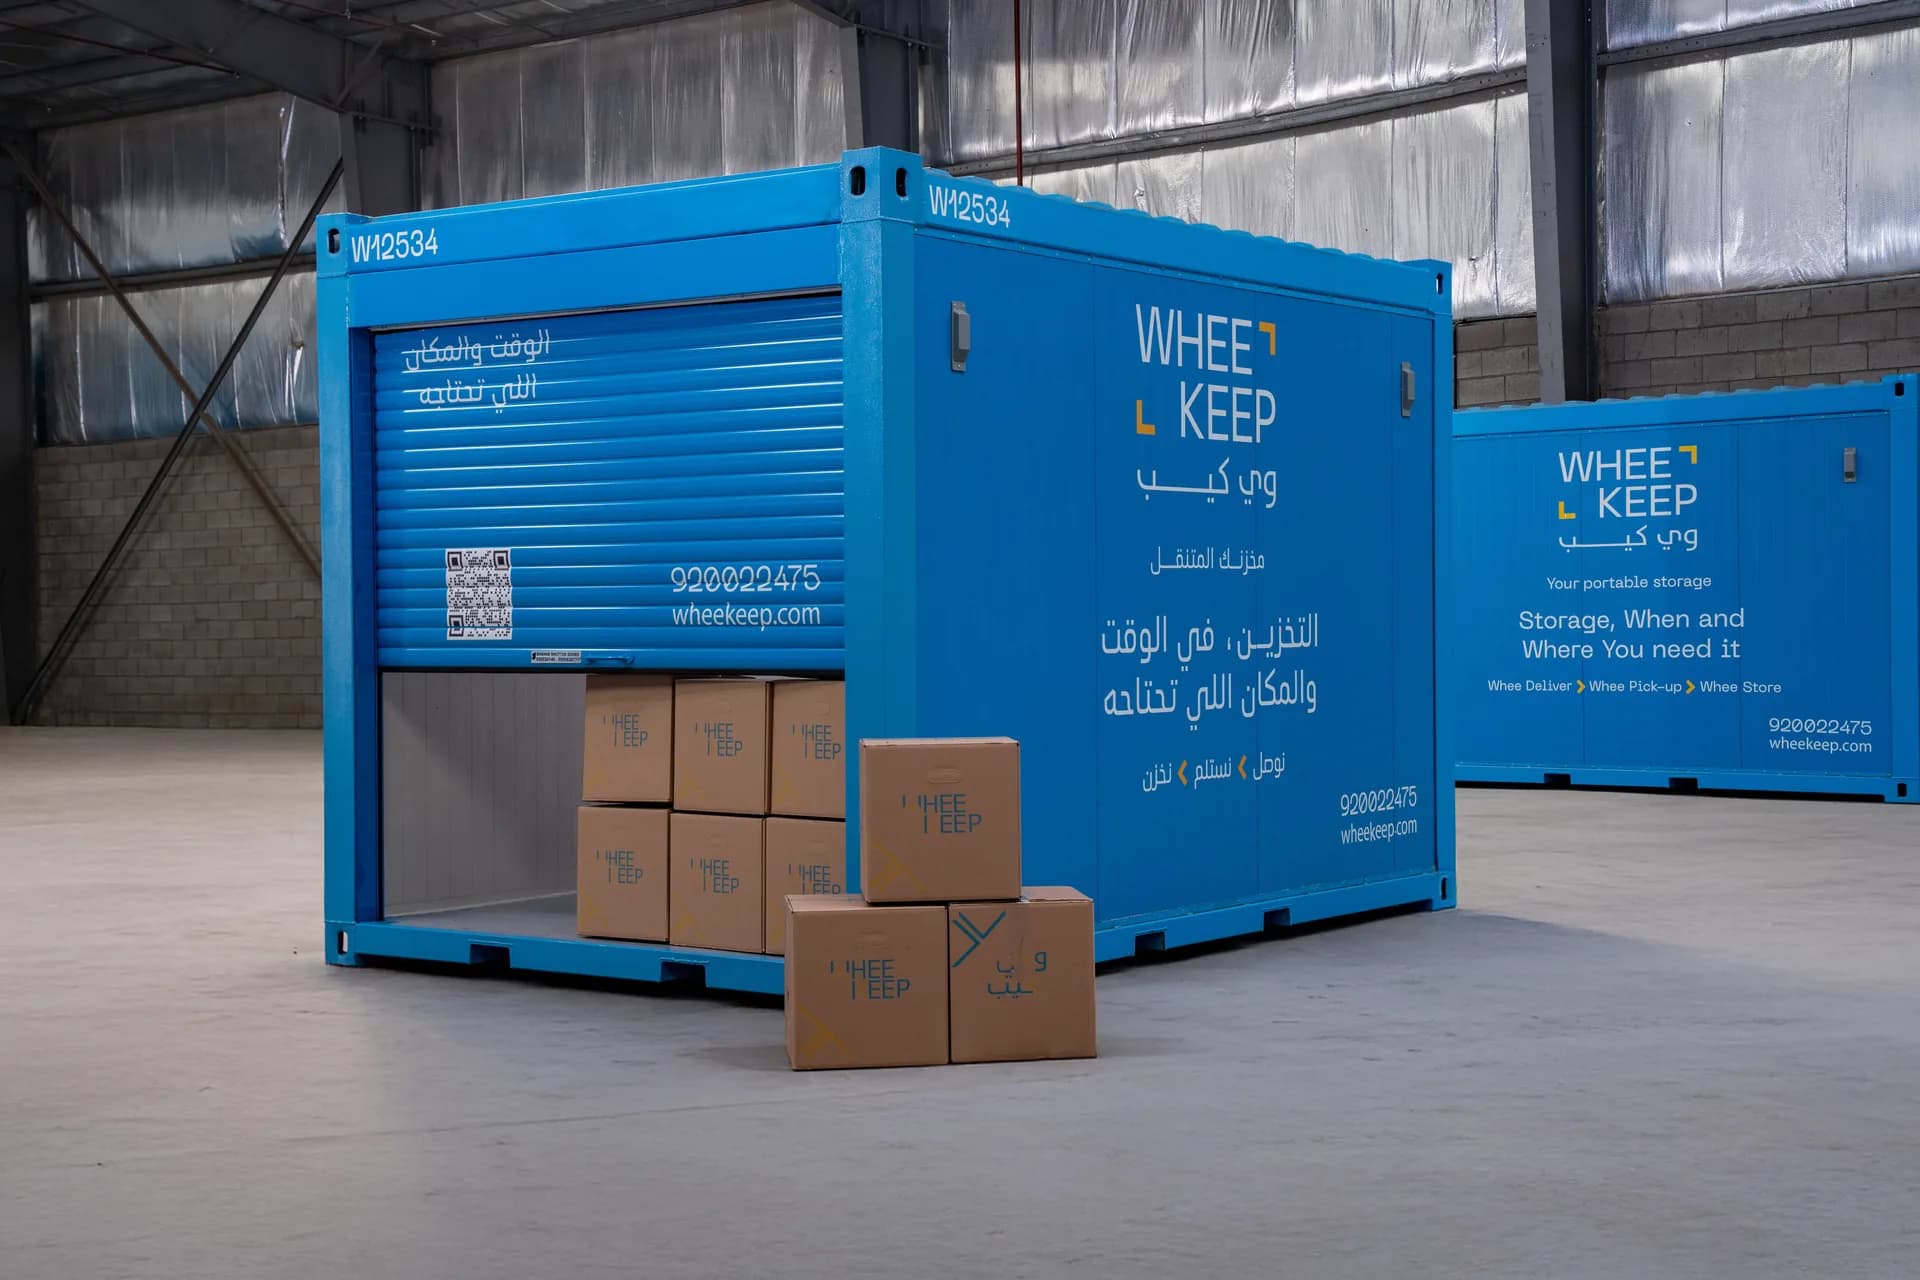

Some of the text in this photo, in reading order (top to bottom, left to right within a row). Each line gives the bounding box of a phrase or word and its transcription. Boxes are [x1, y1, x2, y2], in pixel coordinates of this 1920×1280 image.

[929, 184, 1011, 229] W12534
[351, 227, 438, 263] W12534
[491, 329, 549, 363] الوقت
[1136, 304, 1252, 376] WHEE
[492, 373, 536, 414] اللي
[1181, 381, 1275, 443] KEEP
[1558, 447, 1672, 483] WHEE
[1239, 470, 1276, 508] وي
[1600, 484, 1698, 519] KEEP
[1657, 528, 1698, 552] وي
[670, 564, 821, 593] 920022475
[1547, 576, 1712, 592] Your portable storage
[672, 601, 821, 632] wheekeep.com
[1519, 608, 1745, 633] Storage, When and
[1102, 615, 1167, 664] الوقت
[1178, 618, 1214, 672] في
[1523, 638, 1741, 659] Where You need it
[1186, 672, 1231, 731] اللي
[1241, 668, 1317, 718] والمكان
[1488, 680, 1782, 694] Whee Deliver Whee Pick-up Whee Store
[1769, 717, 1873, 735] 920022475
[1769, 735, 1873, 754] wheekeep.com
[1253, 752, 1285, 780] نوصل
[1340, 785, 1417, 817] 920022475
[1340, 819, 1417, 845] wheekeep.com
